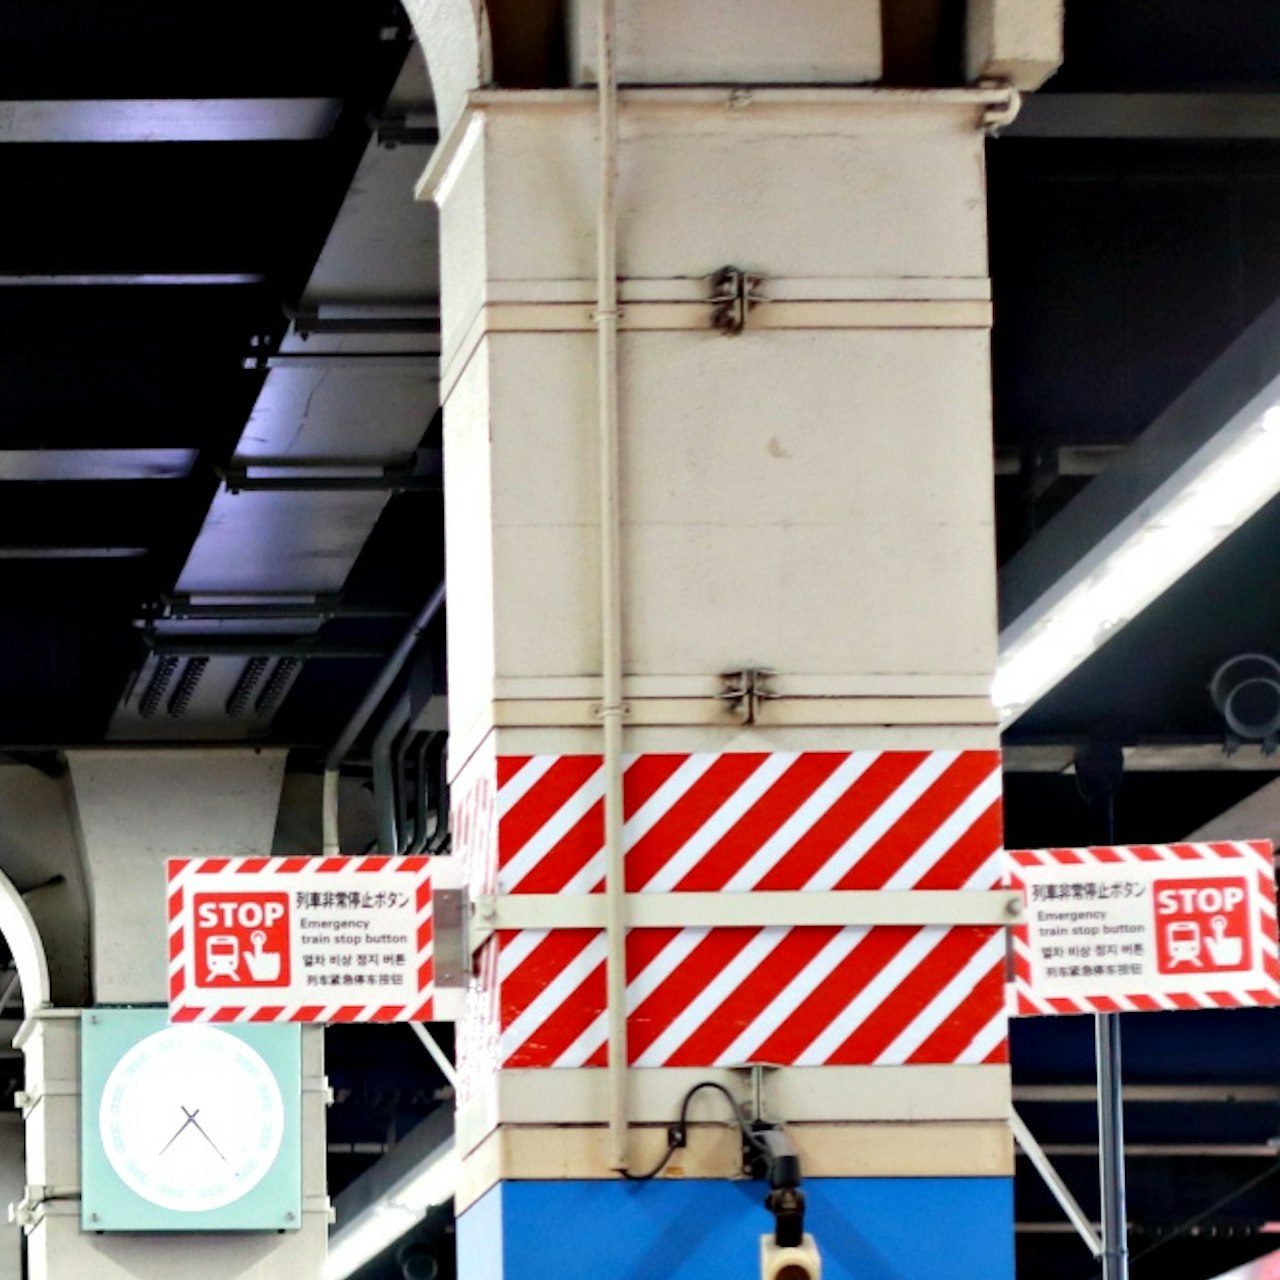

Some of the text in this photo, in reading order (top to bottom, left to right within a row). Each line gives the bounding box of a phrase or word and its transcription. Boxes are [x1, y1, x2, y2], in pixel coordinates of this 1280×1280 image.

[296, 891, 410, 909] 列車非常停止ボタン
[1032, 882, 1146, 902] 列車非常停止ボタン
[1158, 887, 1244, 914] STOP
[198, 902, 284, 928] STOP
[1037, 910, 1106, 922] Emergency
[300, 918, 370, 930] Emergency
[1040, 923, 1145, 937] train stop button
[301, 934, 407, 946] train stop button
